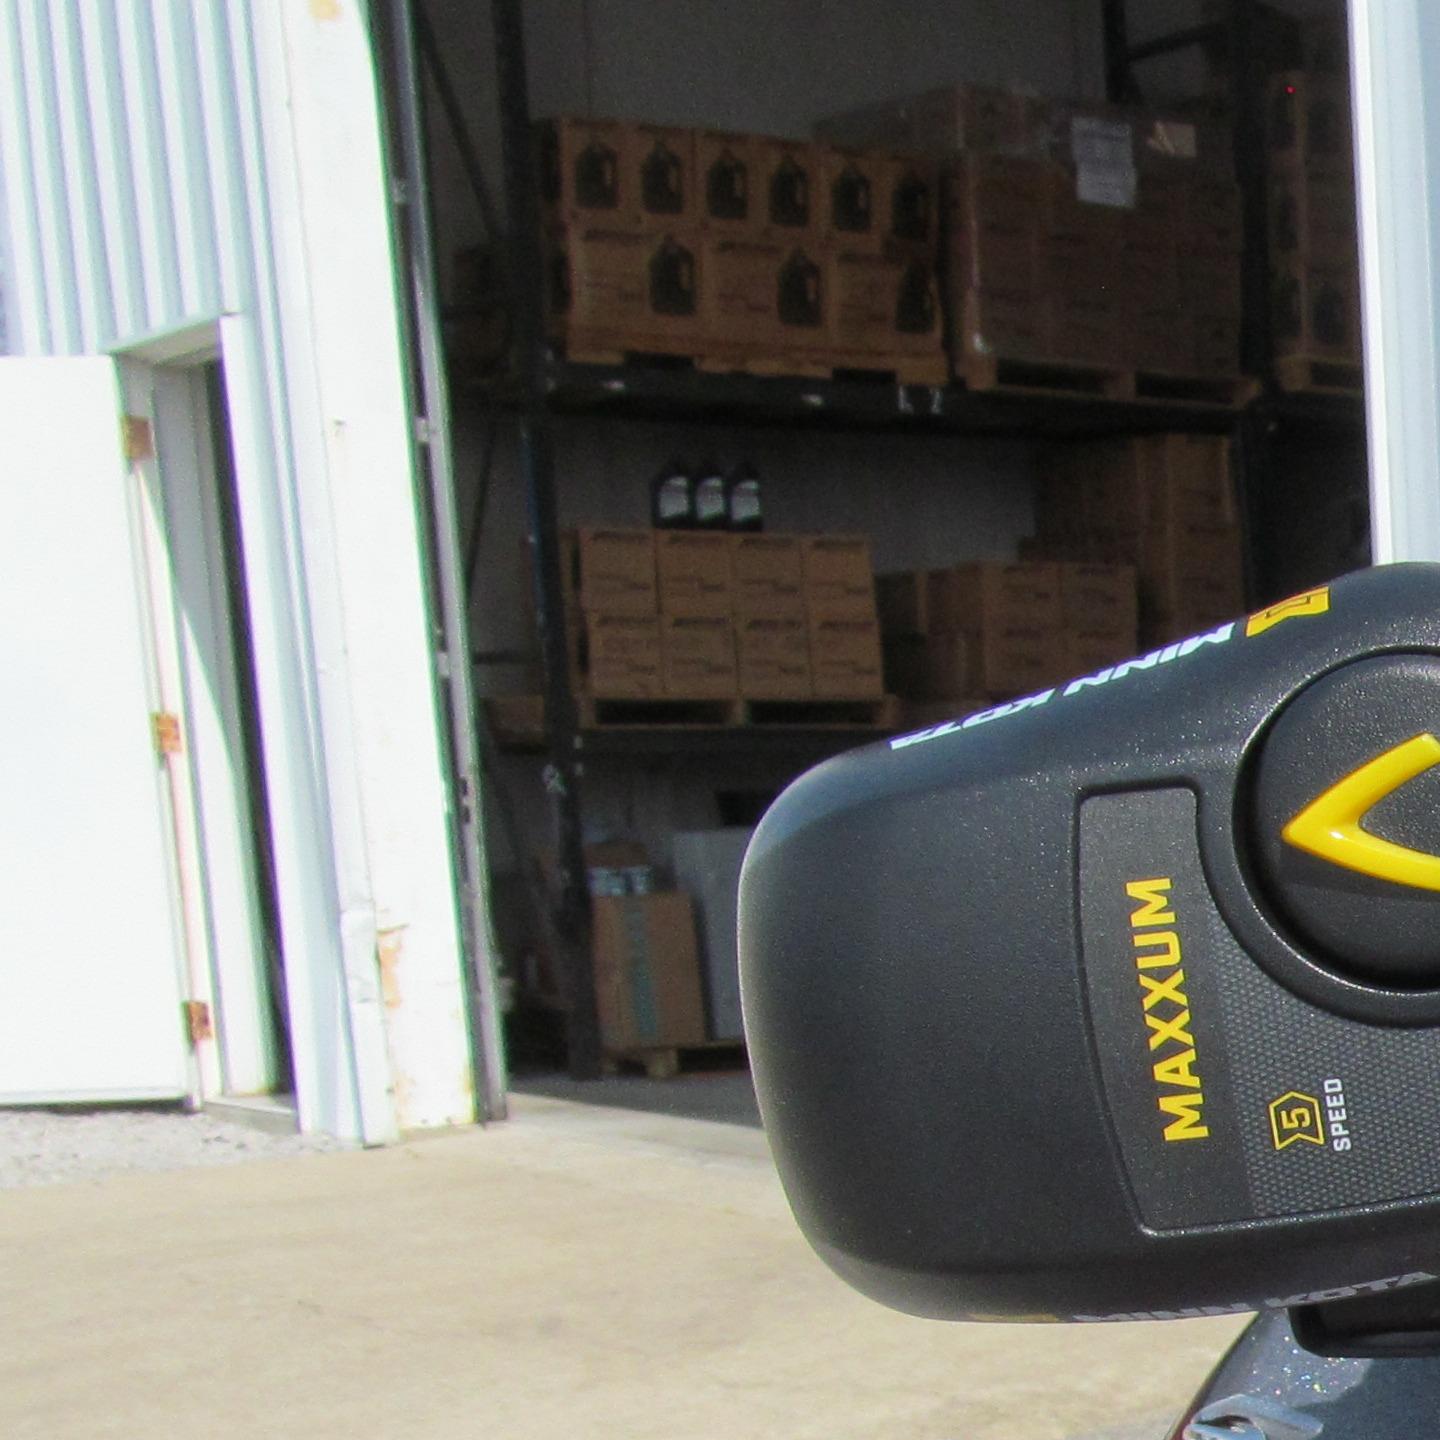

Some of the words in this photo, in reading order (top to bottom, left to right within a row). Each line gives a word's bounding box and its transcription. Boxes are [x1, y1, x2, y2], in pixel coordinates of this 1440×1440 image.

[1126, 878, 1209, 1141] MAXXUM
[1281, 1107, 1311, 1129] 5
[1323, 1078, 1351, 1151] SPEED
